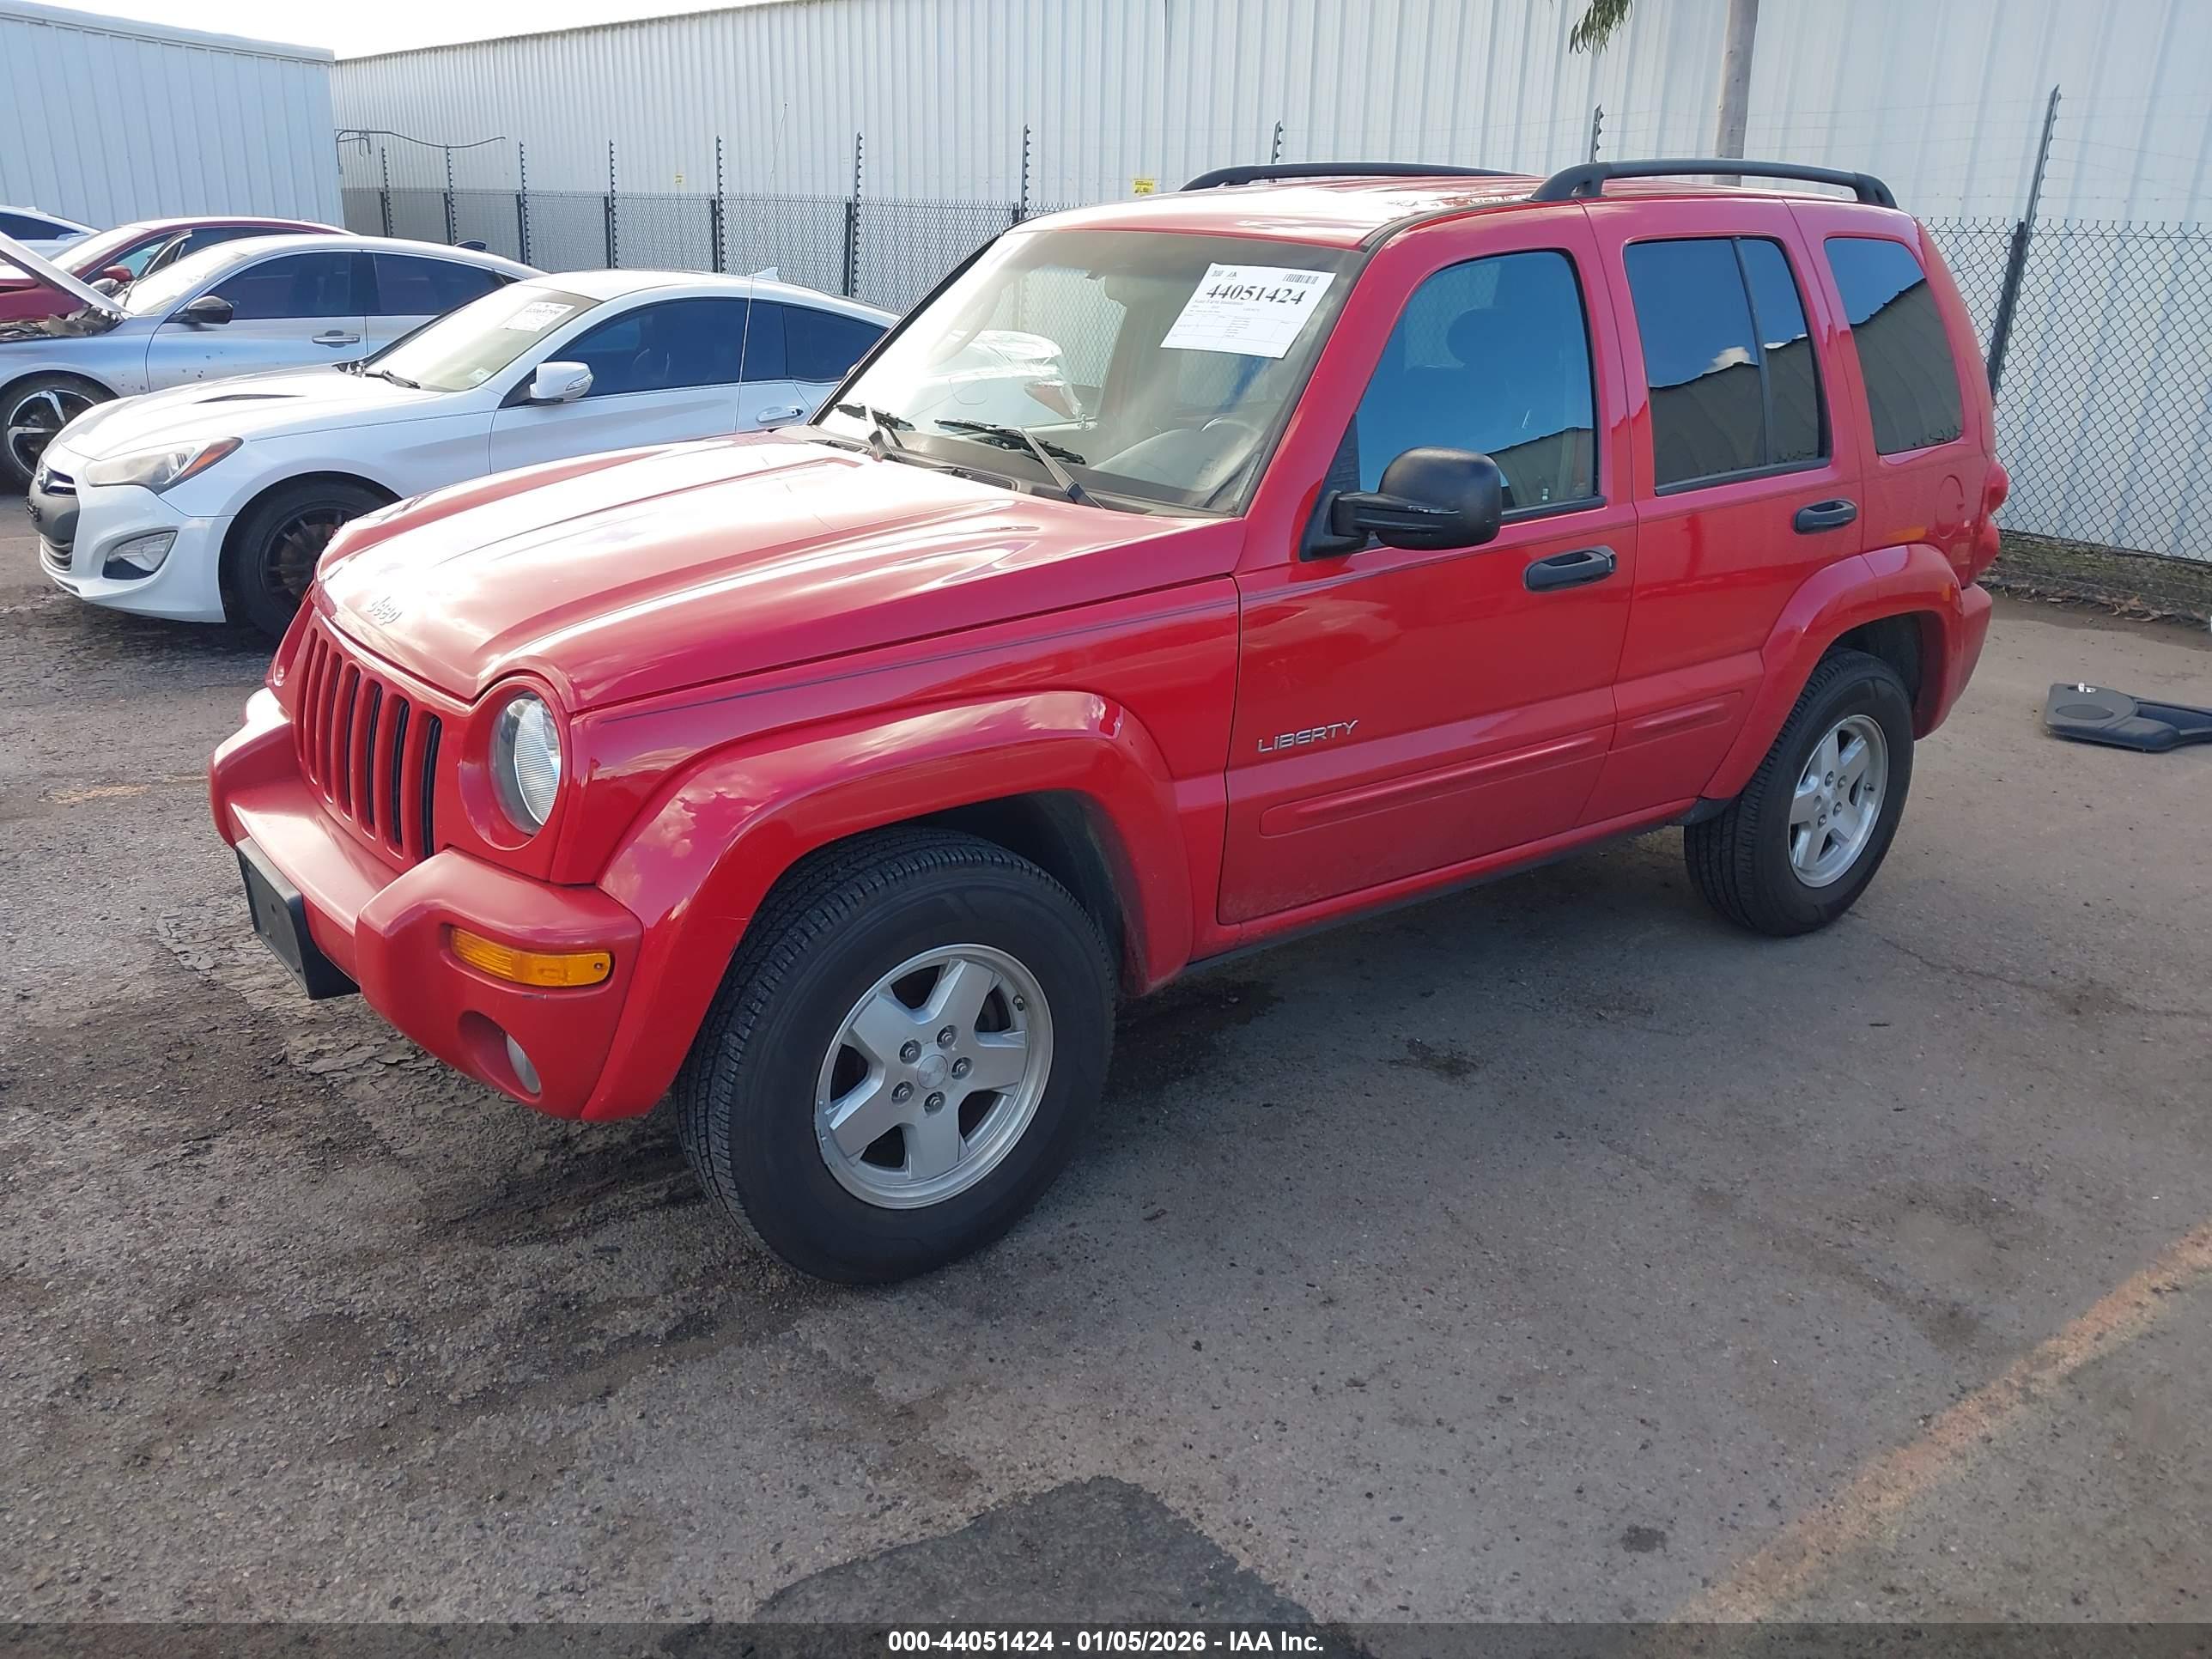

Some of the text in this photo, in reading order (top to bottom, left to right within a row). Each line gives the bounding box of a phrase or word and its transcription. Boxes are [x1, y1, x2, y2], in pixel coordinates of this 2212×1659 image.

[1206, 283, 1307, 305] 44051424
[367, 596, 403, 625] Jeep
[1257, 719, 1359, 753] LIBERTY
